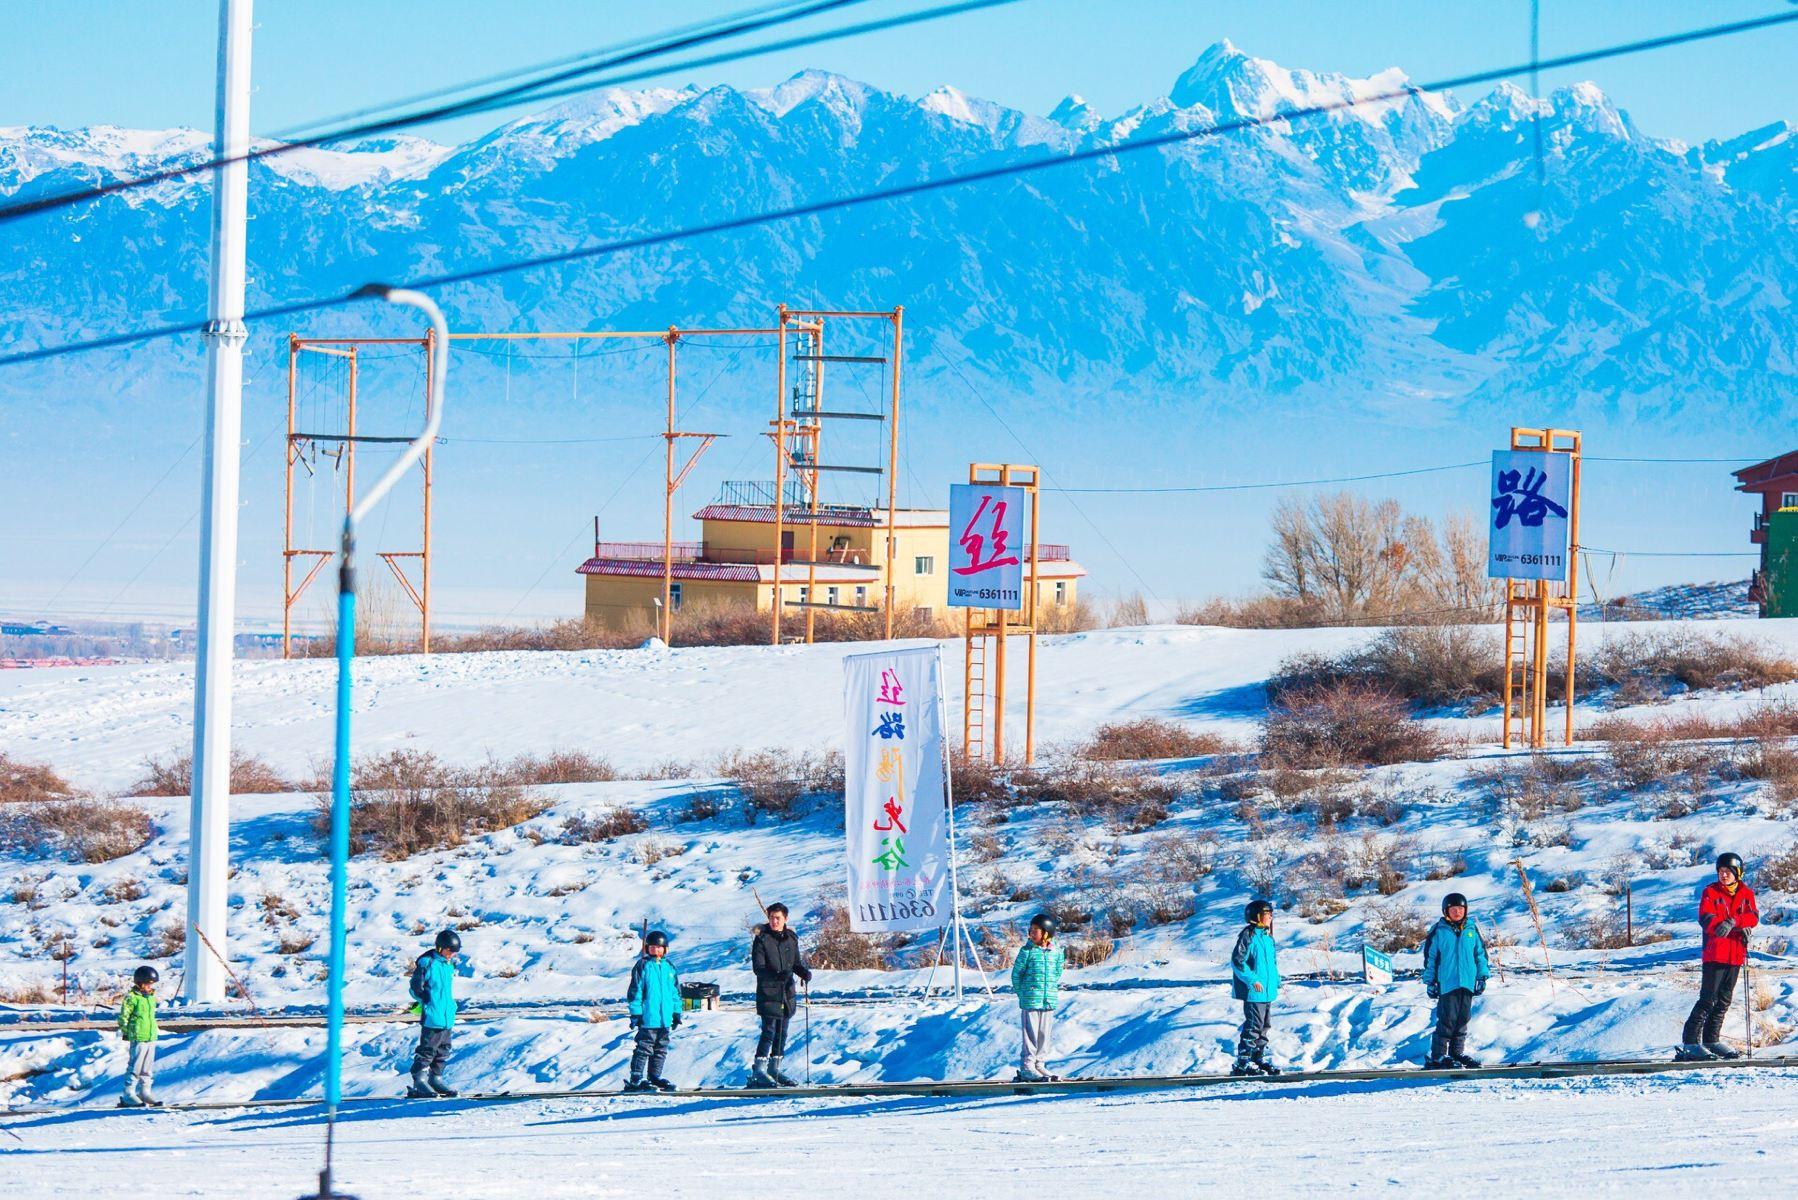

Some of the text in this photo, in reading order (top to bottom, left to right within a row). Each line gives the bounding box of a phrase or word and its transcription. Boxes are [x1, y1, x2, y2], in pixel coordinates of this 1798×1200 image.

[1491, 466, 1568, 530] 路
[1494, 553, 1507, 562] VIP
[1520, 554, 1561, 566] 6361111
[954, 588, 966, 597] VIP
[979, 589, 1018, 600] 6361111
